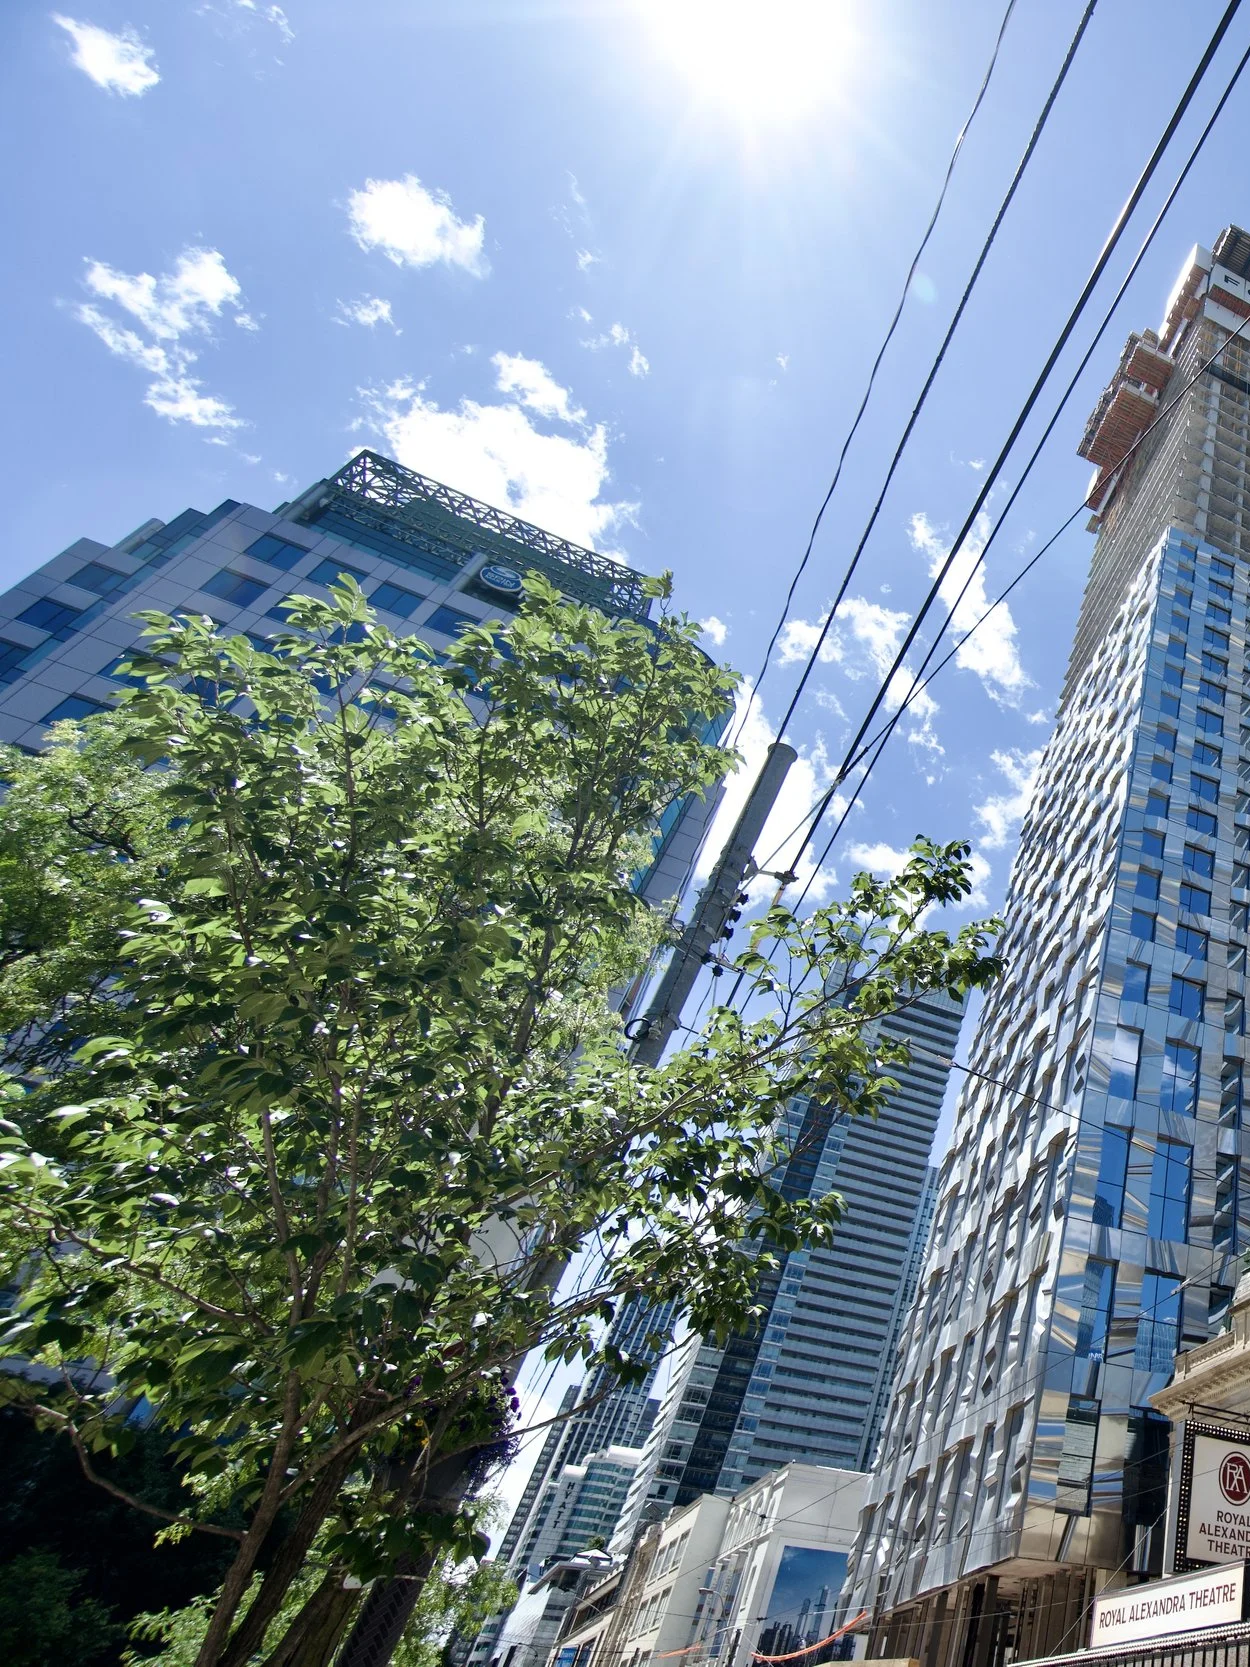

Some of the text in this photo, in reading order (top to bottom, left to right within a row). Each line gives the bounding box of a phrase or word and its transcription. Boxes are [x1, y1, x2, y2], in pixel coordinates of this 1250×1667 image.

[552, 1481, 576, 1529] HYATT
[1098, 1582, 1238, 1630] ROYAL ALEXANDRA THEATRE
